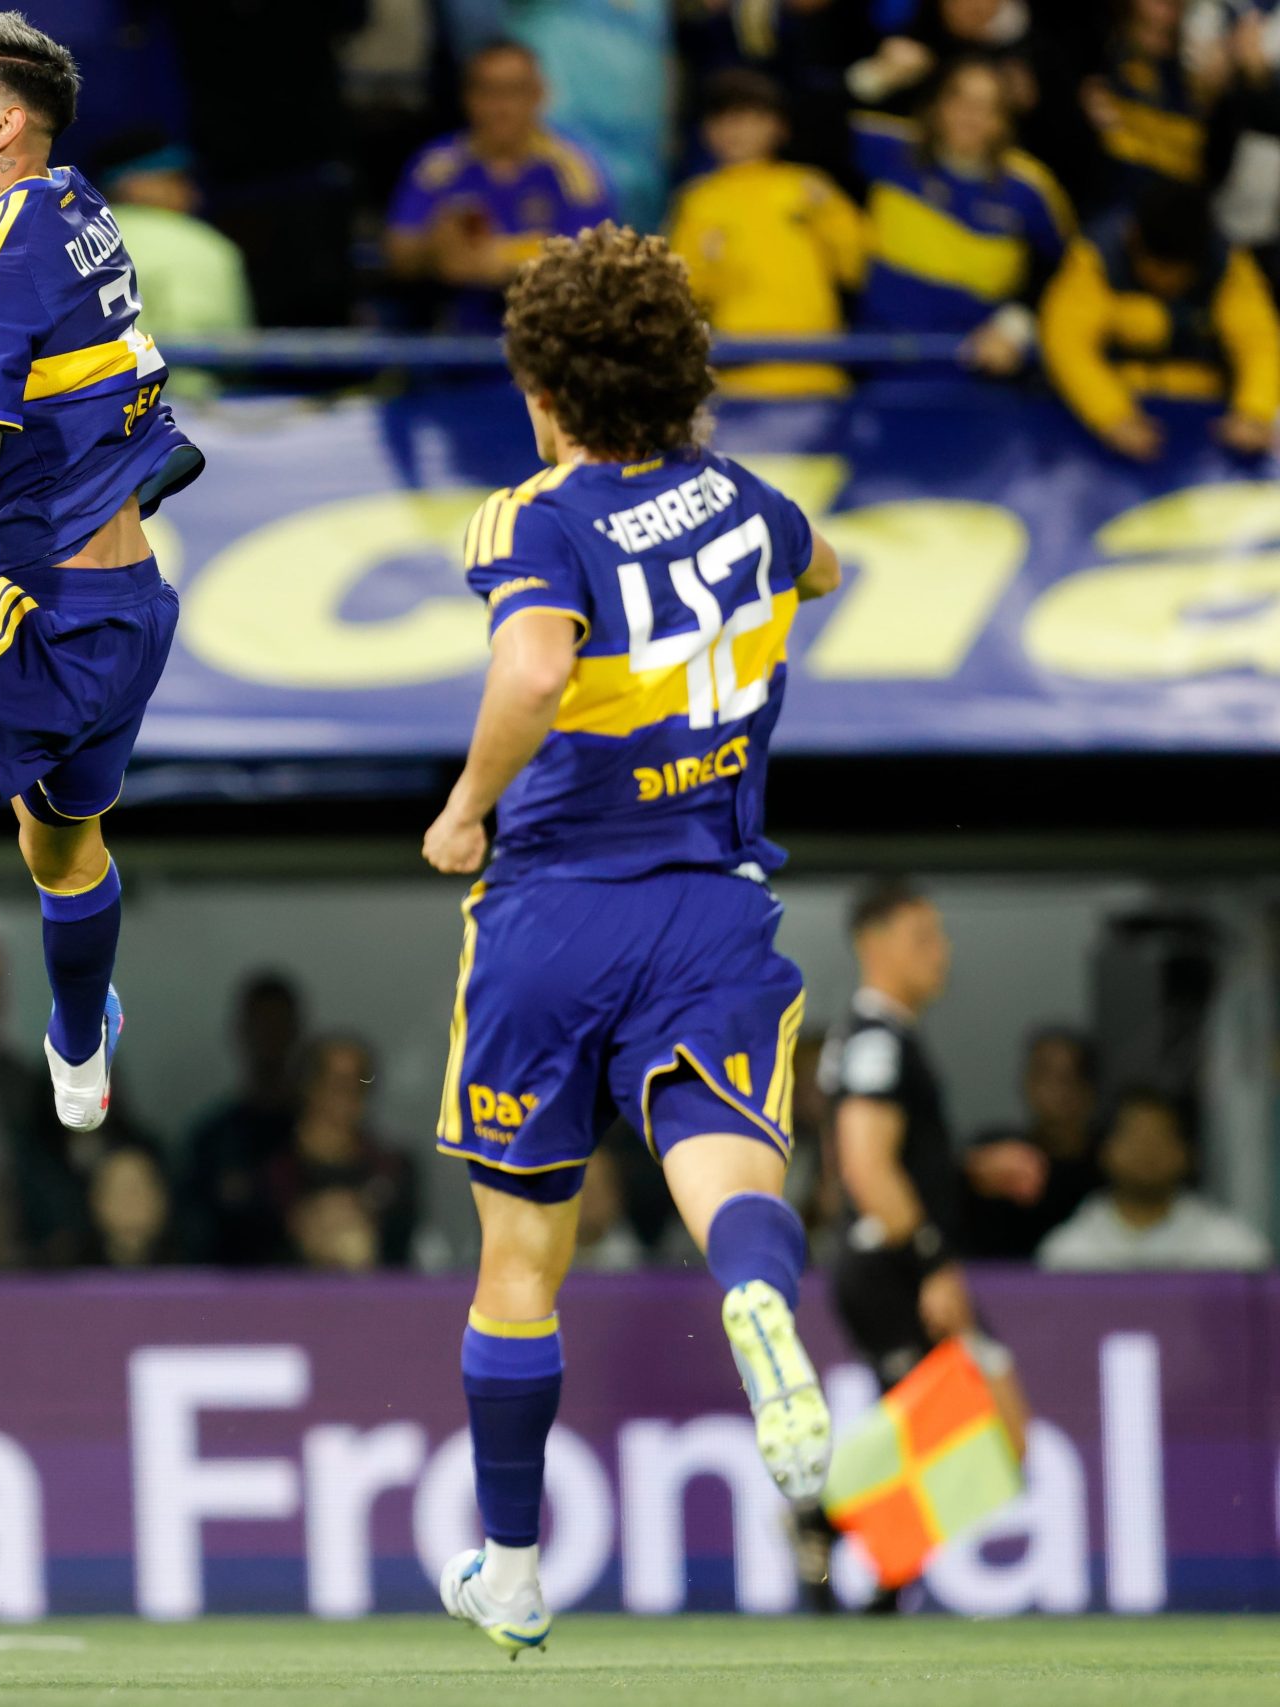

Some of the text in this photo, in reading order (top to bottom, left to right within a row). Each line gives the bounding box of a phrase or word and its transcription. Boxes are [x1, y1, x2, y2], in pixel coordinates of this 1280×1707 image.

[593, 466, 739, 554] HERRERA
[617, 513, 773, 730] 42
[128, 1331, 1168, 1616] Fronal
